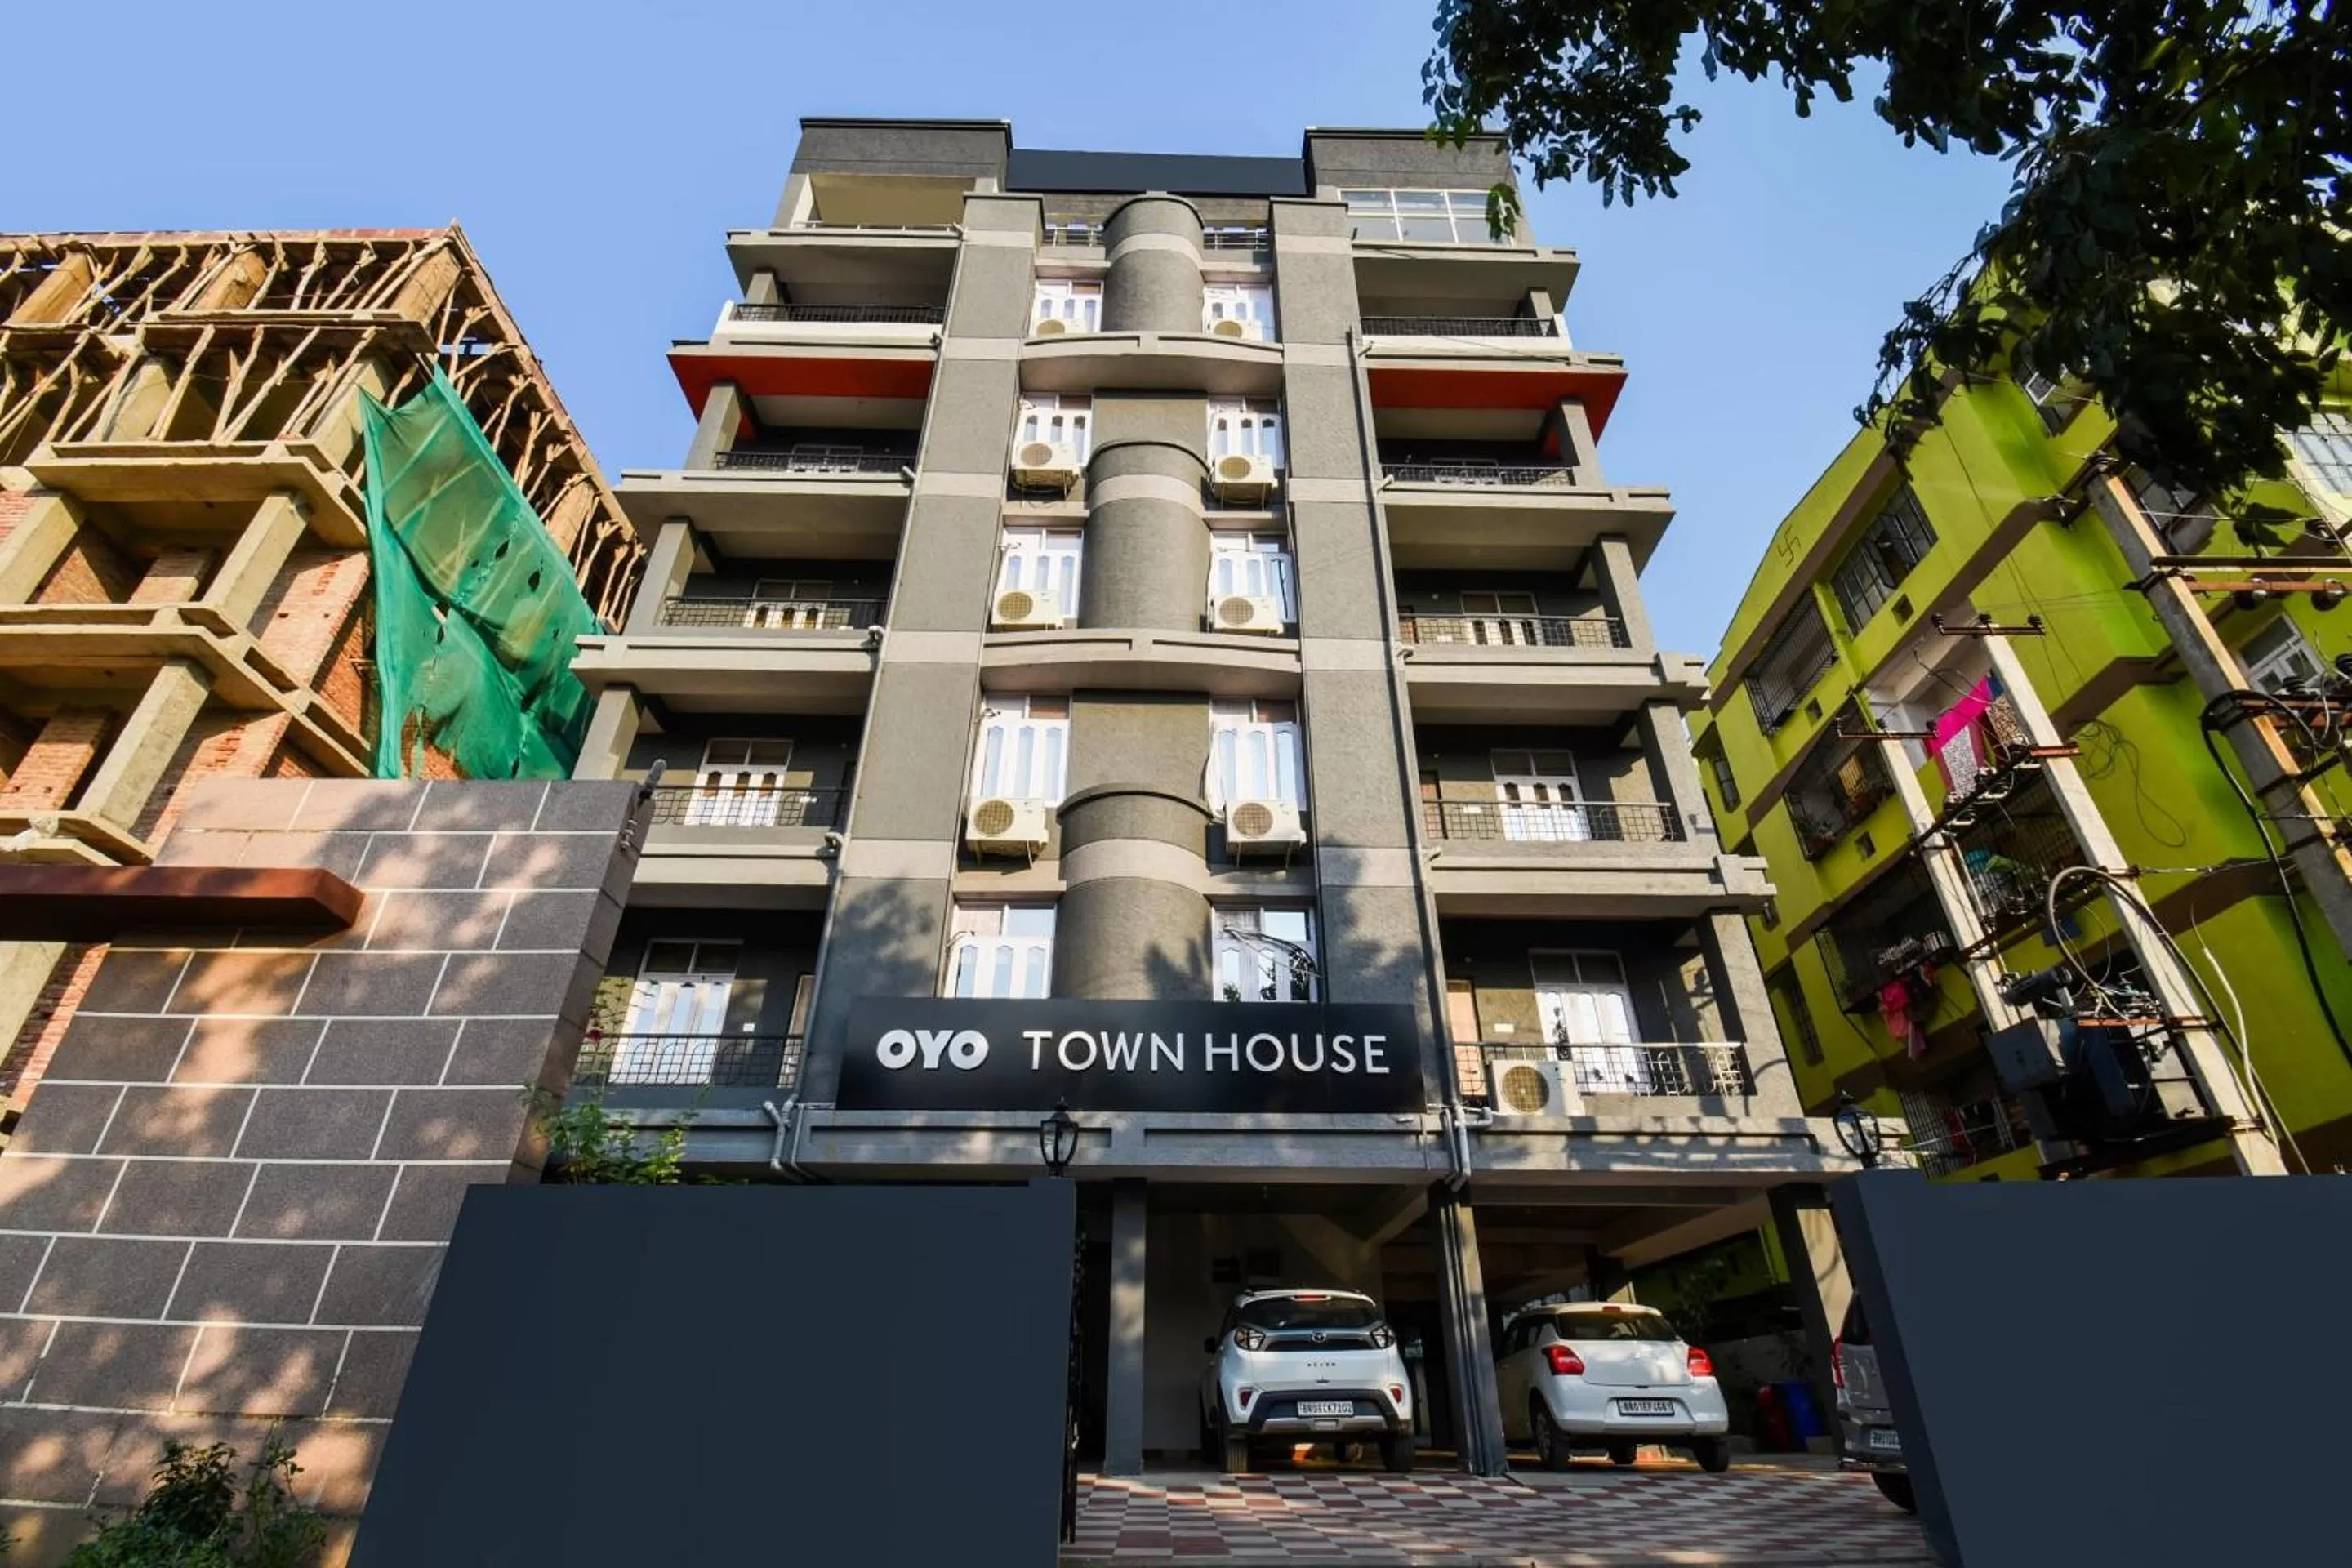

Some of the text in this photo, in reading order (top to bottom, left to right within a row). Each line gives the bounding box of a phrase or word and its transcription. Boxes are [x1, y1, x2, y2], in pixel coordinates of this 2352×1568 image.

[876, 1029, 1390, 1073] OYO TOWN HOUSE
